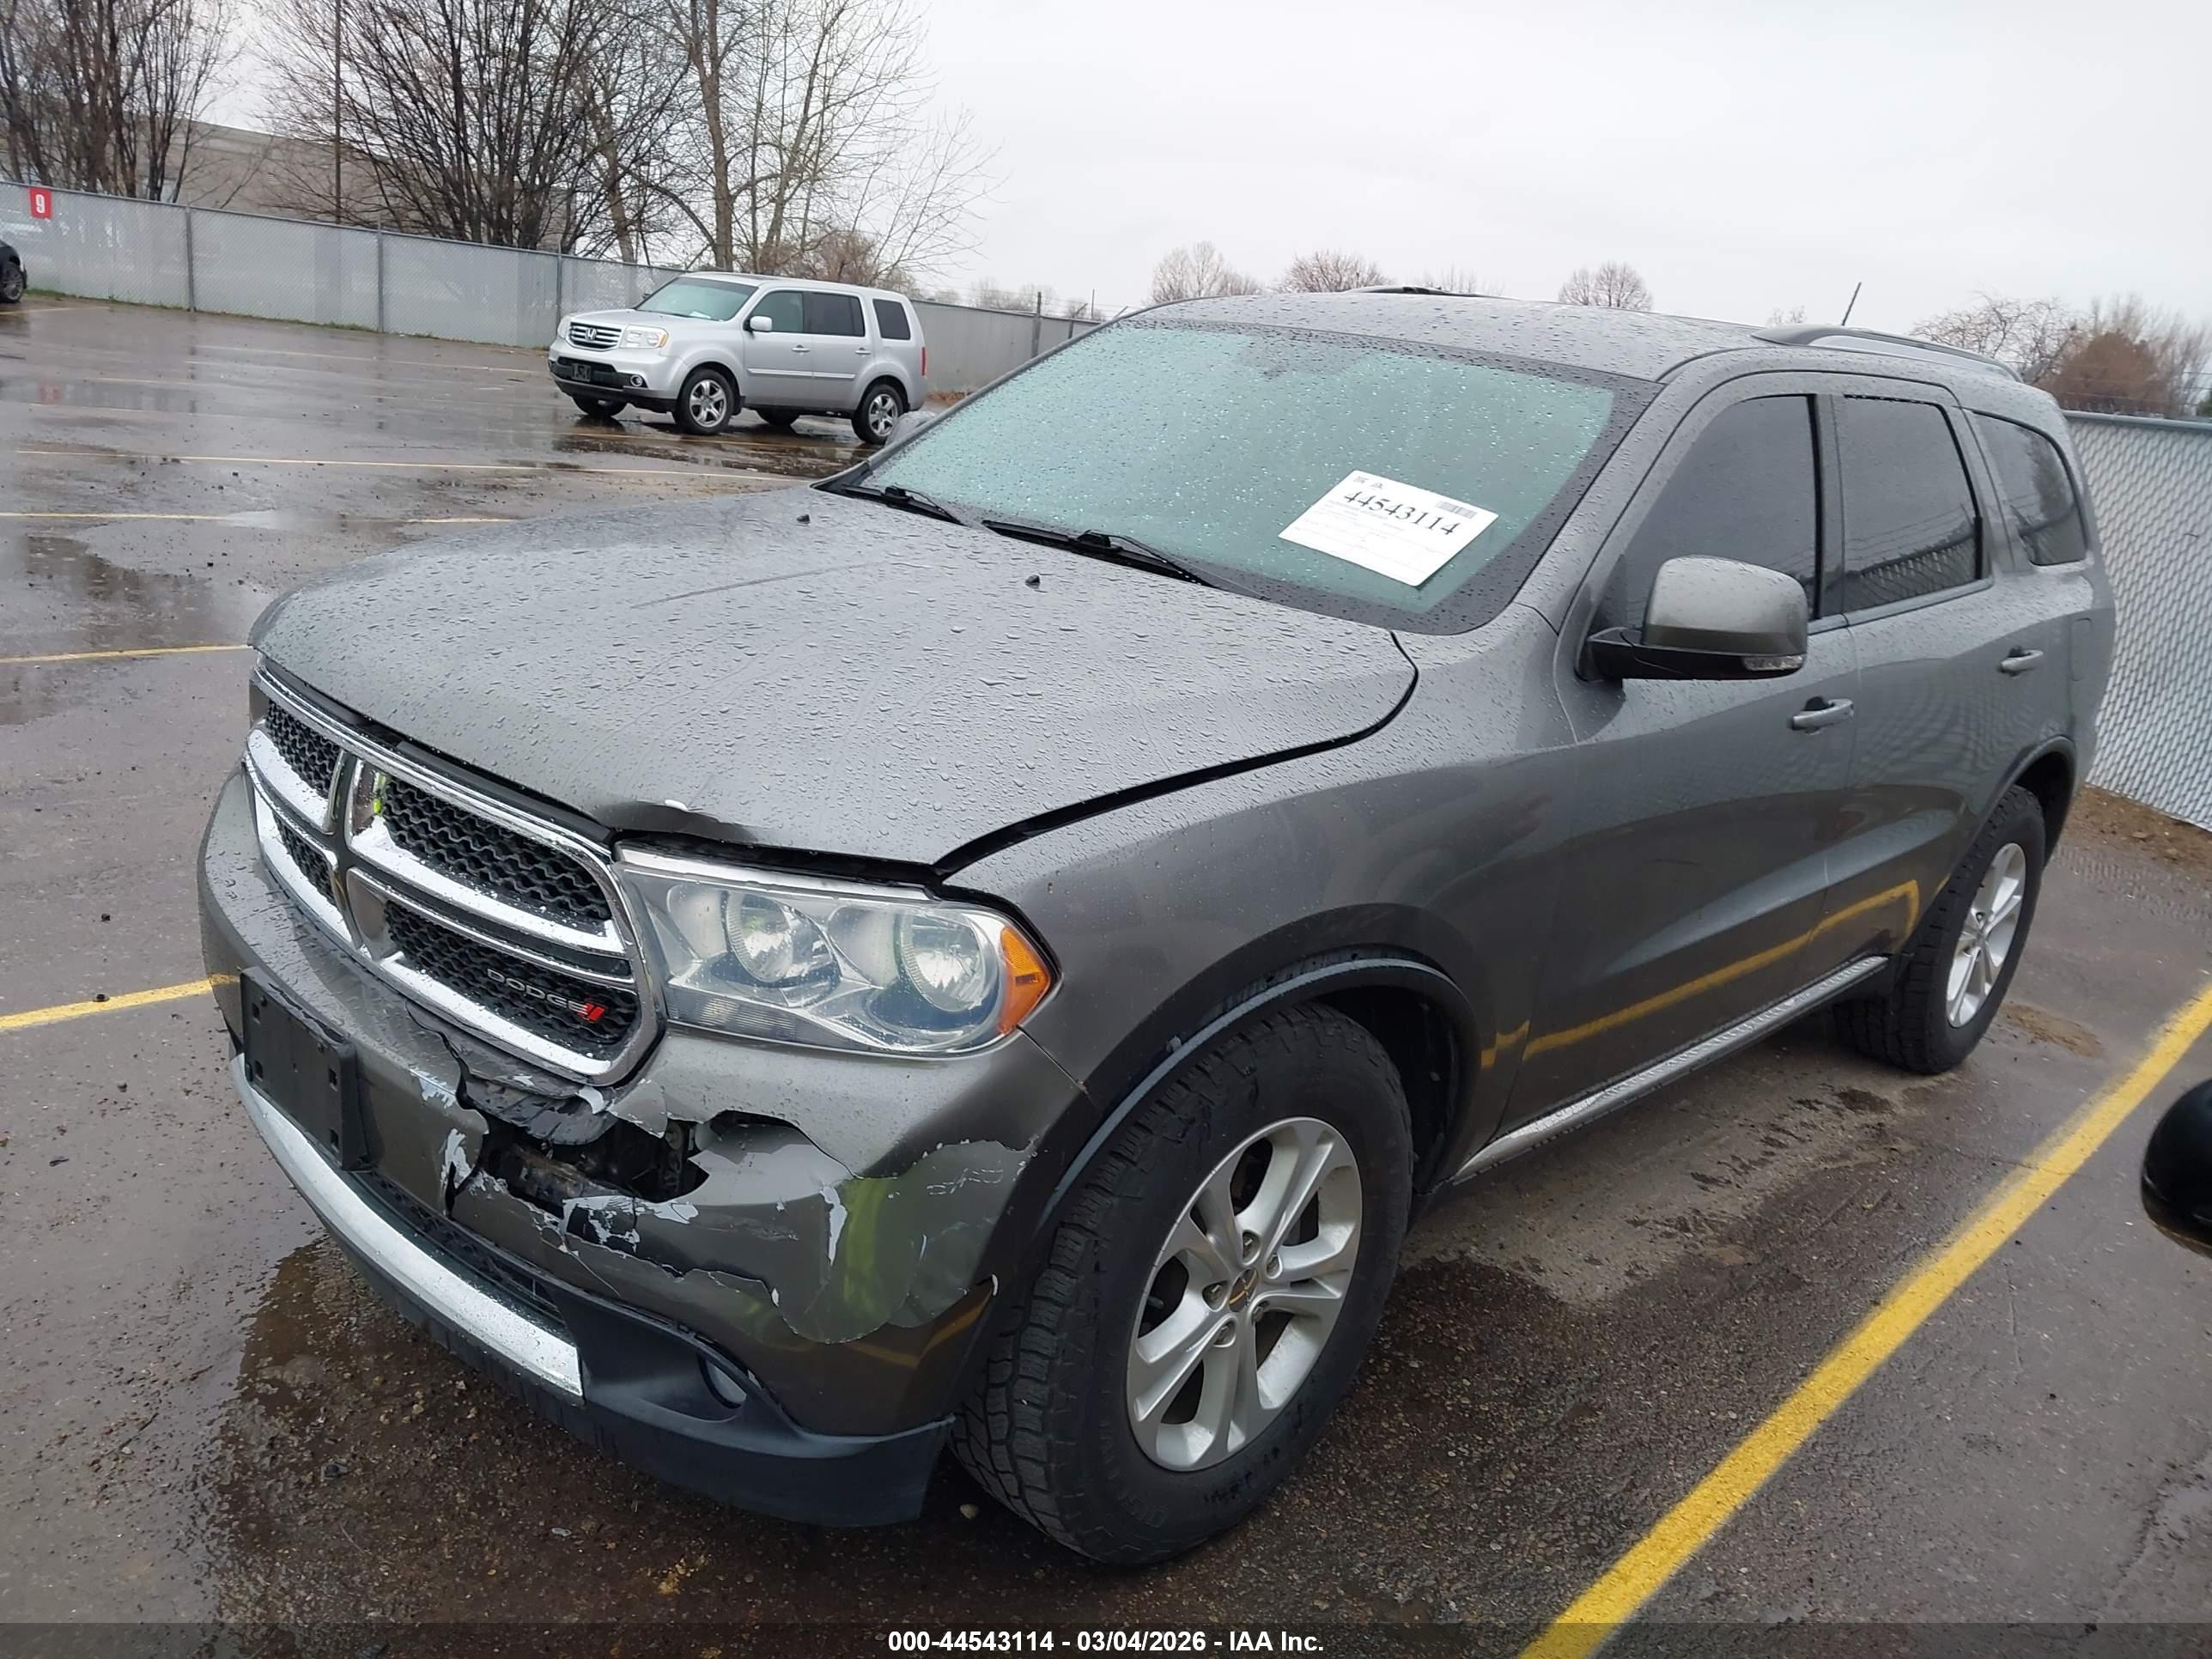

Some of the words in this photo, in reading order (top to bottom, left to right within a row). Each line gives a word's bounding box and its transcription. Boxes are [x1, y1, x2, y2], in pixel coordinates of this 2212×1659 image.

[35, 194, 46, 214] 9
[1343, 490, 1461, 536] 44543114
[487, 968, 589, 1017] DODGE
